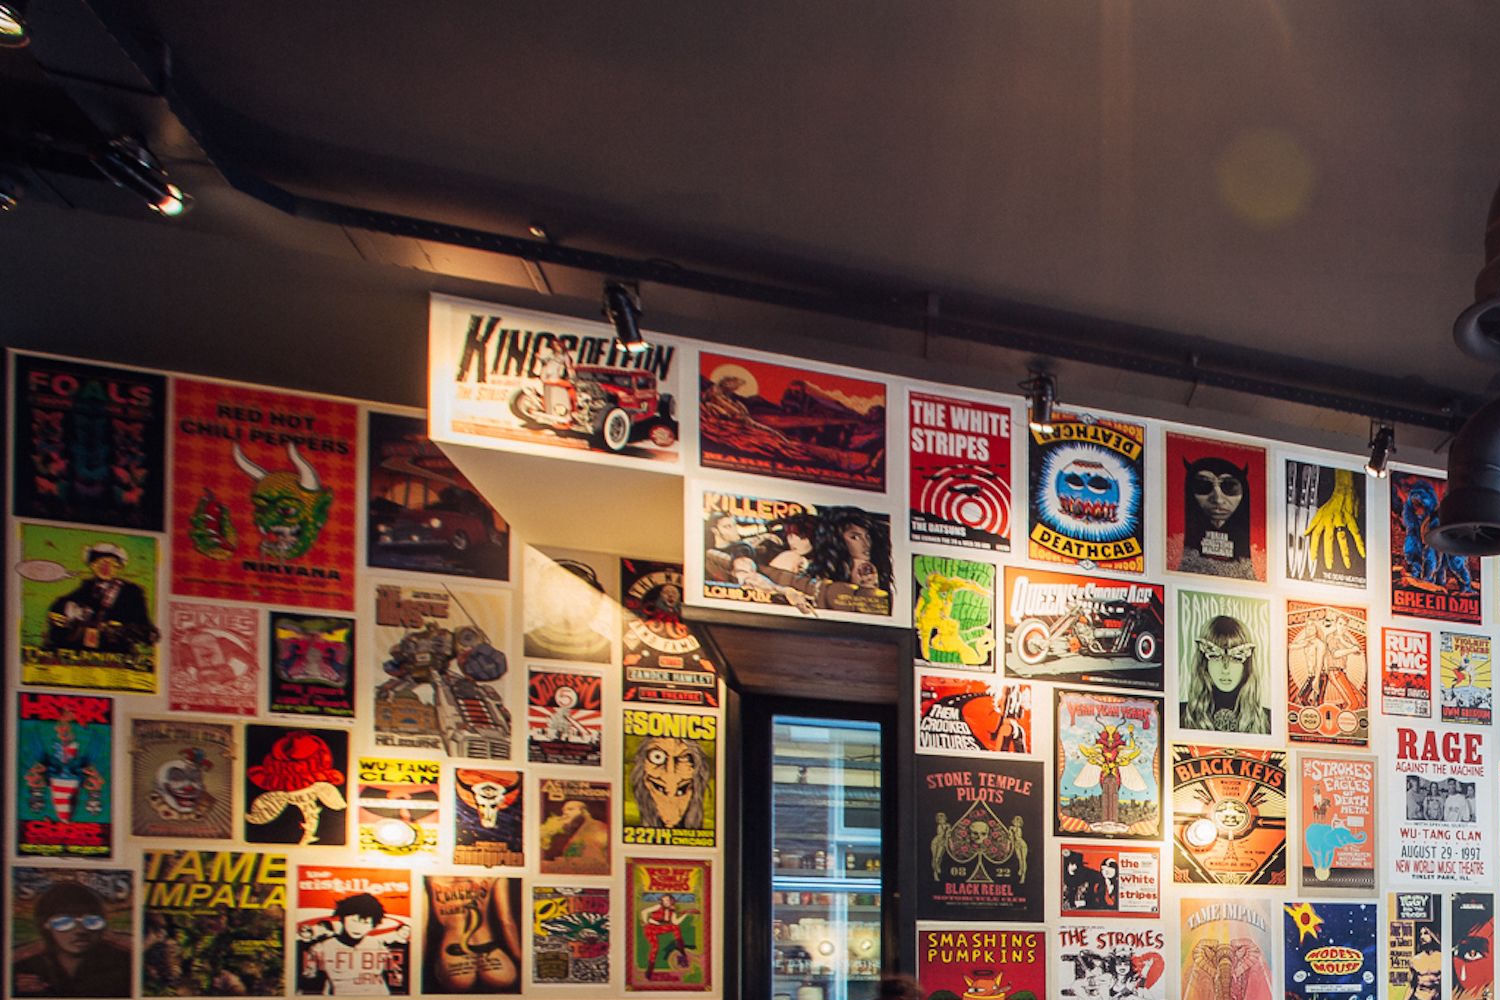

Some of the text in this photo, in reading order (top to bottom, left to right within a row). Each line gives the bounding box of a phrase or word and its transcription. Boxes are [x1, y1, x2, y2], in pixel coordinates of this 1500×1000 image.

[28, 369, 152, 407] FOALS
[216, 403, 317, 432] RED HOT
[911, 400, 1010, 438] THE WHITE
[180, 419, 350, 455] CHILI PEPPERS
[911, 429, 990, 462] STRIPES
[703, 452, 771, 469] MARK
[911, 520, 928, 532] THE
[1039, 530, 1134, 558] DEATHCAB
[241, 560, 341, 581] NIRVANA
[1010, 576, 1080, 624] QUEENS
[1128, 585, 1153, 604] AGE
[1394, 589, 1479, 614] GREEN DAY
[1386, 636, 1428, 654] RUN
[1386, 652, 1428, 670] DMC
[929, 704, 960, 720] THEM
[633, 712, 717, 741] SONICS
[920, 718, 972, 735] CROOKED
[920, 733, 981, 752] VULTURES
[1397, 728, 1483, 765] RAGE
[360, 772, 439, 785] CLAN
[1174, 758, 1284, 788] BLACK KEYS
[1311, 760, 1372, 781] STROKES
[1396, 762, 1484, 777] AGAINST THE MACHINE
[926, 771, 1033, 797] STONE TEMPLE
[1323, 777, 1371, 795] EAGLES
[956, 787, 1005, 806] PILOTS
[1333, 793, 1370, 807] DEATH
[1456, 831, 1482, 841] CLAN
[1401, 845, 1481, 861] AUGUST 29 1997
[144, 850, 288, 885] TAME
[950, 866, 1012, 878] 08 22
[1120, 859, 1139, 869] the
[1396, 860, 1484, 876] NEW WORLD MUSIC THEATRE
[299, 877, 410, 895] distillers
[1120, 874, 1155, 885] white
[144, 881, 287, 910] IMPALA
[945, 883, 1014, 897] BLACK REBEL
[1120, 891, 1157, 900] stripes
[1400, 895, 1429, 907] IGGY
[1186, 902, 1267, 933] TAME IMPALA
[928, 932, 1038, 949] SMASHING
[1058, 929, 1164, 950] THE STROKES
[928, 949, 1037, 964] PUMPKINS
[1307, 948, 1361, 960] MODEST
[1313, 961, 1361, 974] MOUSE
